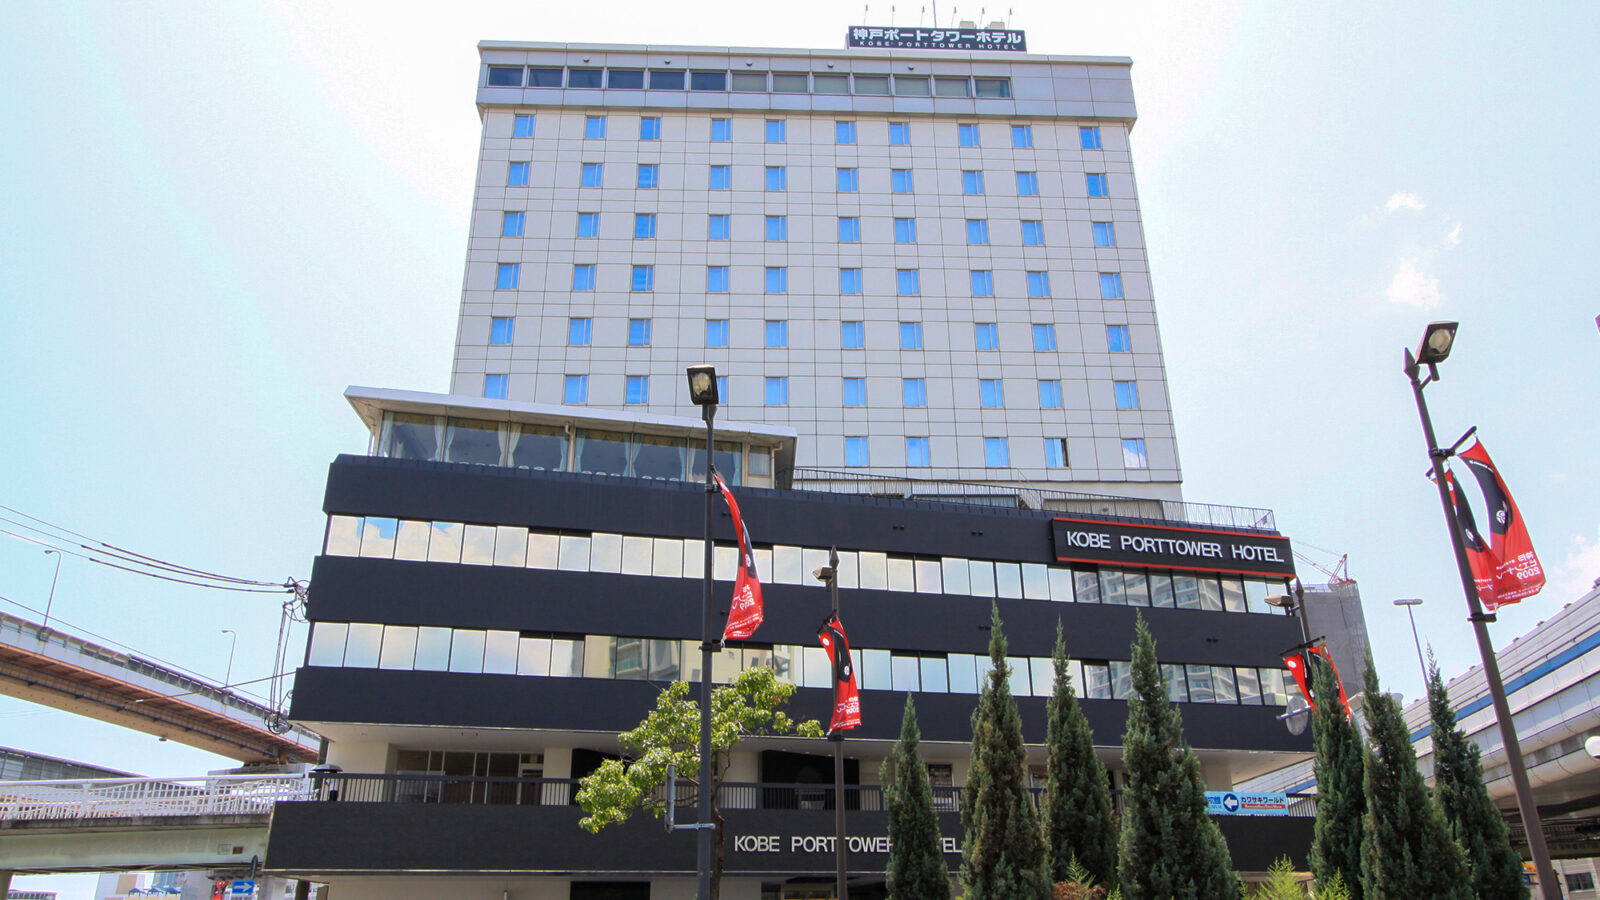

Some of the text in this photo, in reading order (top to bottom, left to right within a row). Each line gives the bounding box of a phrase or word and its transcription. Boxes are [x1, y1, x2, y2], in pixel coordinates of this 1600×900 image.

[853, 28, 1021, 44] 神戸ポートタワーホテル
[1067, 531, 1285, 563] KOBE PORTTOWER HOTEL
[734, 836, 893, 853] KOBE PORTOWE
